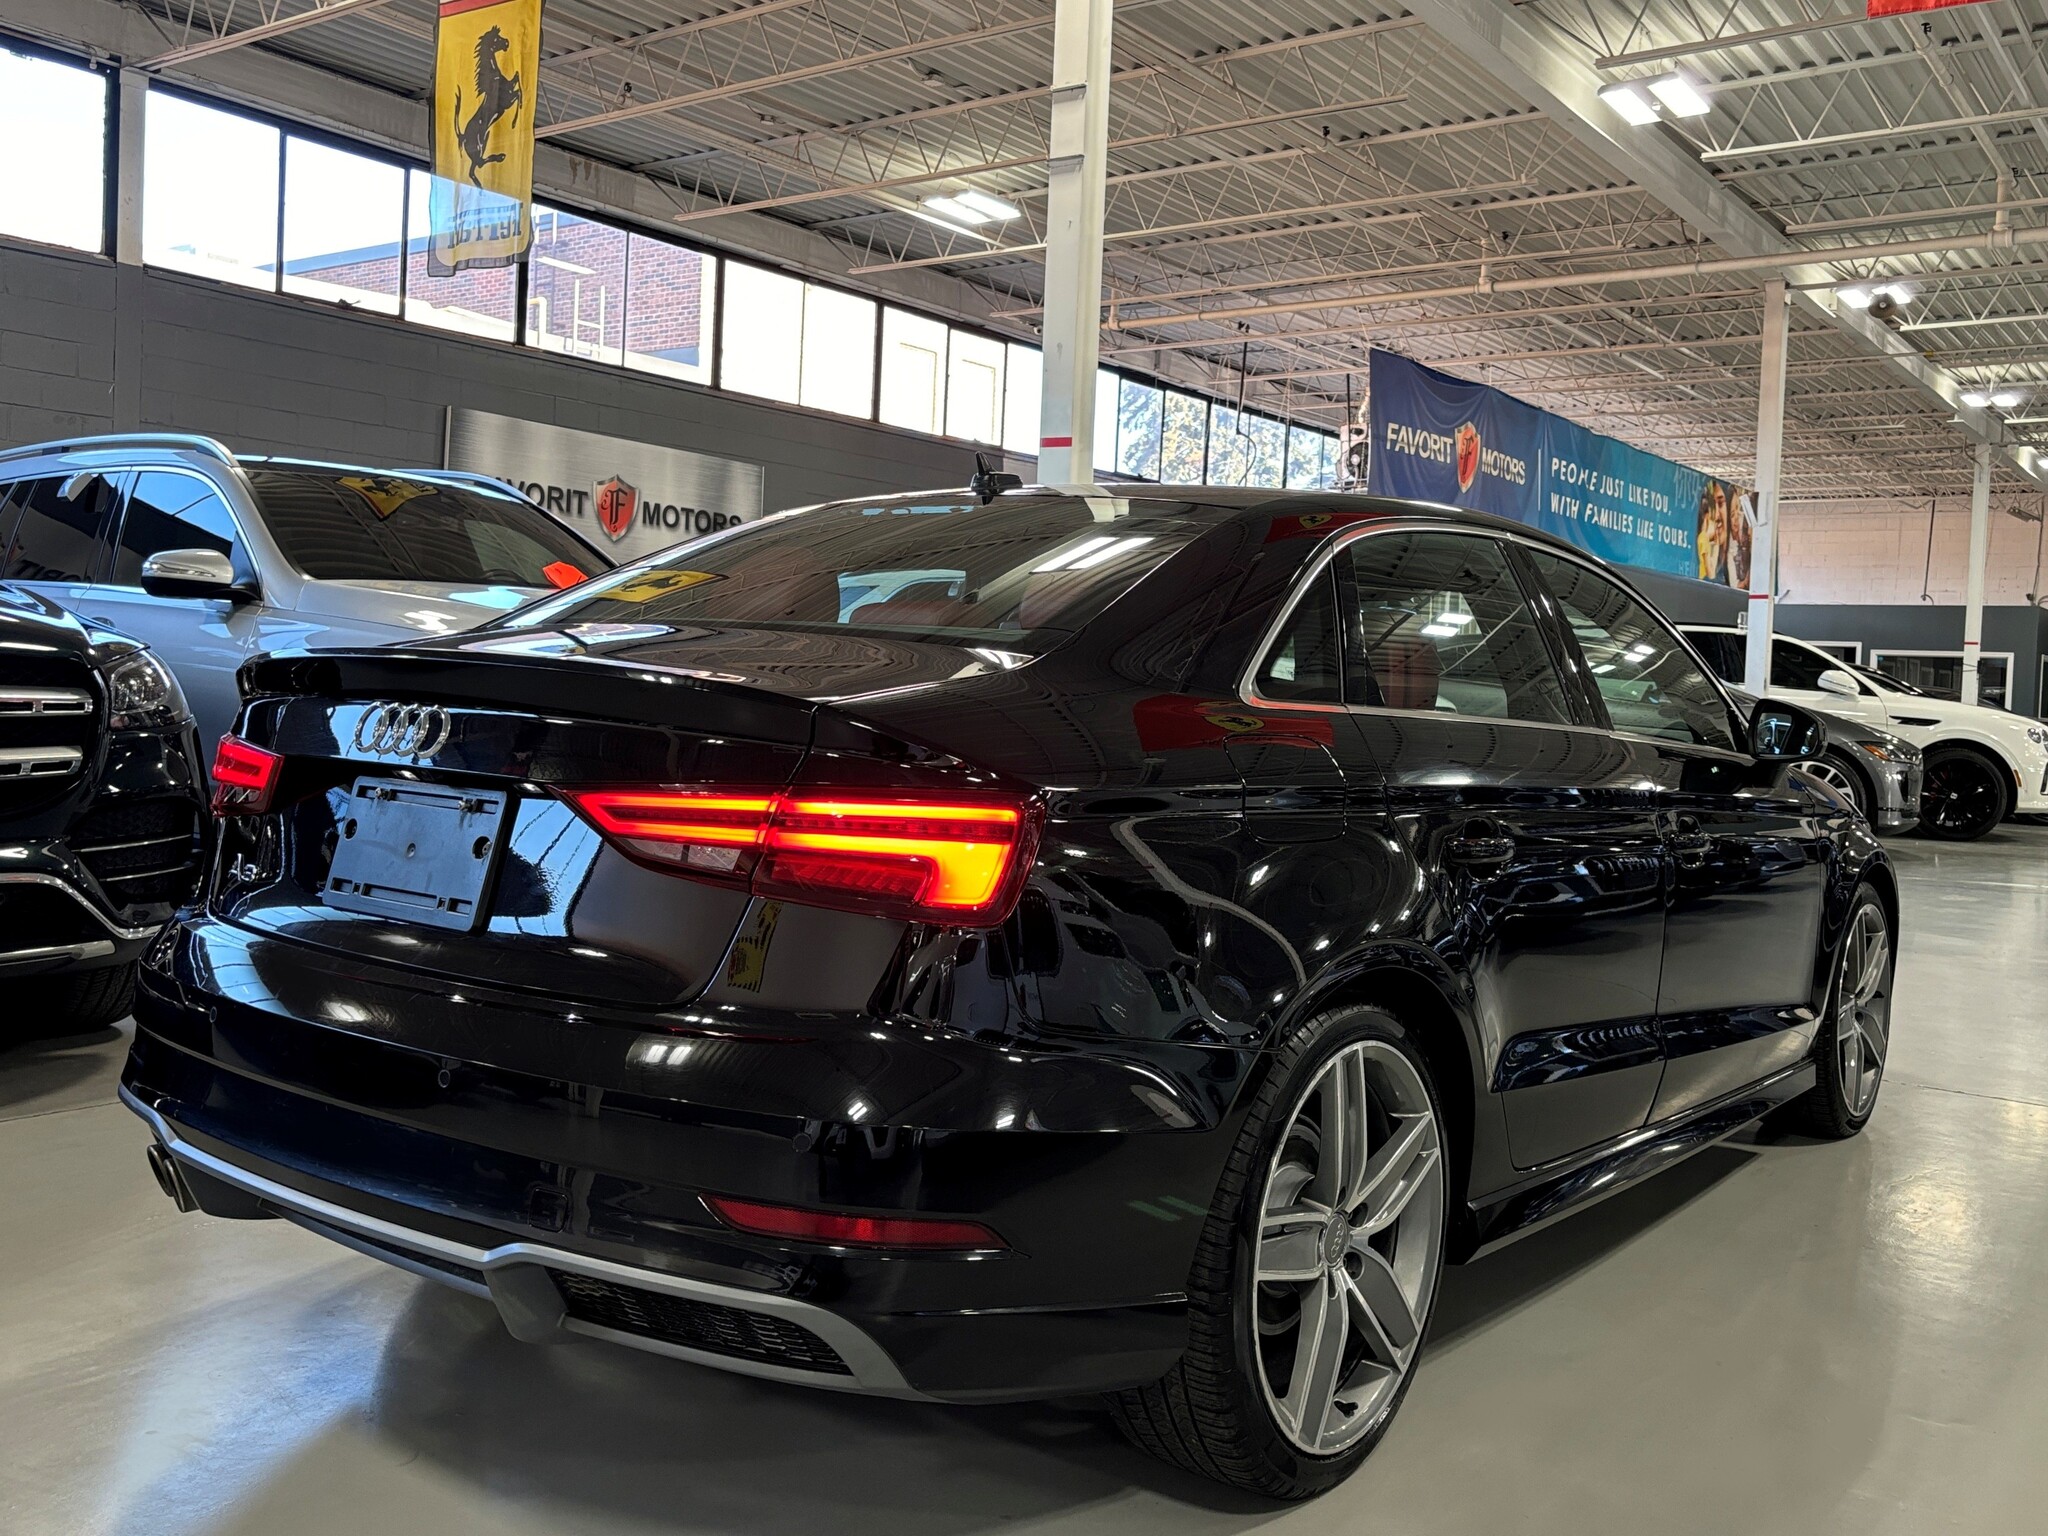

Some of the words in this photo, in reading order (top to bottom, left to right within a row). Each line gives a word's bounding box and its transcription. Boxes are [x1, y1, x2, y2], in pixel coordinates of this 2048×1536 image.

[1386, 422, 1454, 464] FAVORIT
[1482, 447, 1526, 485] MOTORS
[1600, 475, 1624, 499] JUST
[1628, 483, 1649, 507] LIKE
[1551, 492, 1580, 519] WITH
[1585, 503, 1633, 534] FAMILIES
[1637, 518, 1653, 540] LIKE
[1658, 524, 1691, 549] YOURS.
